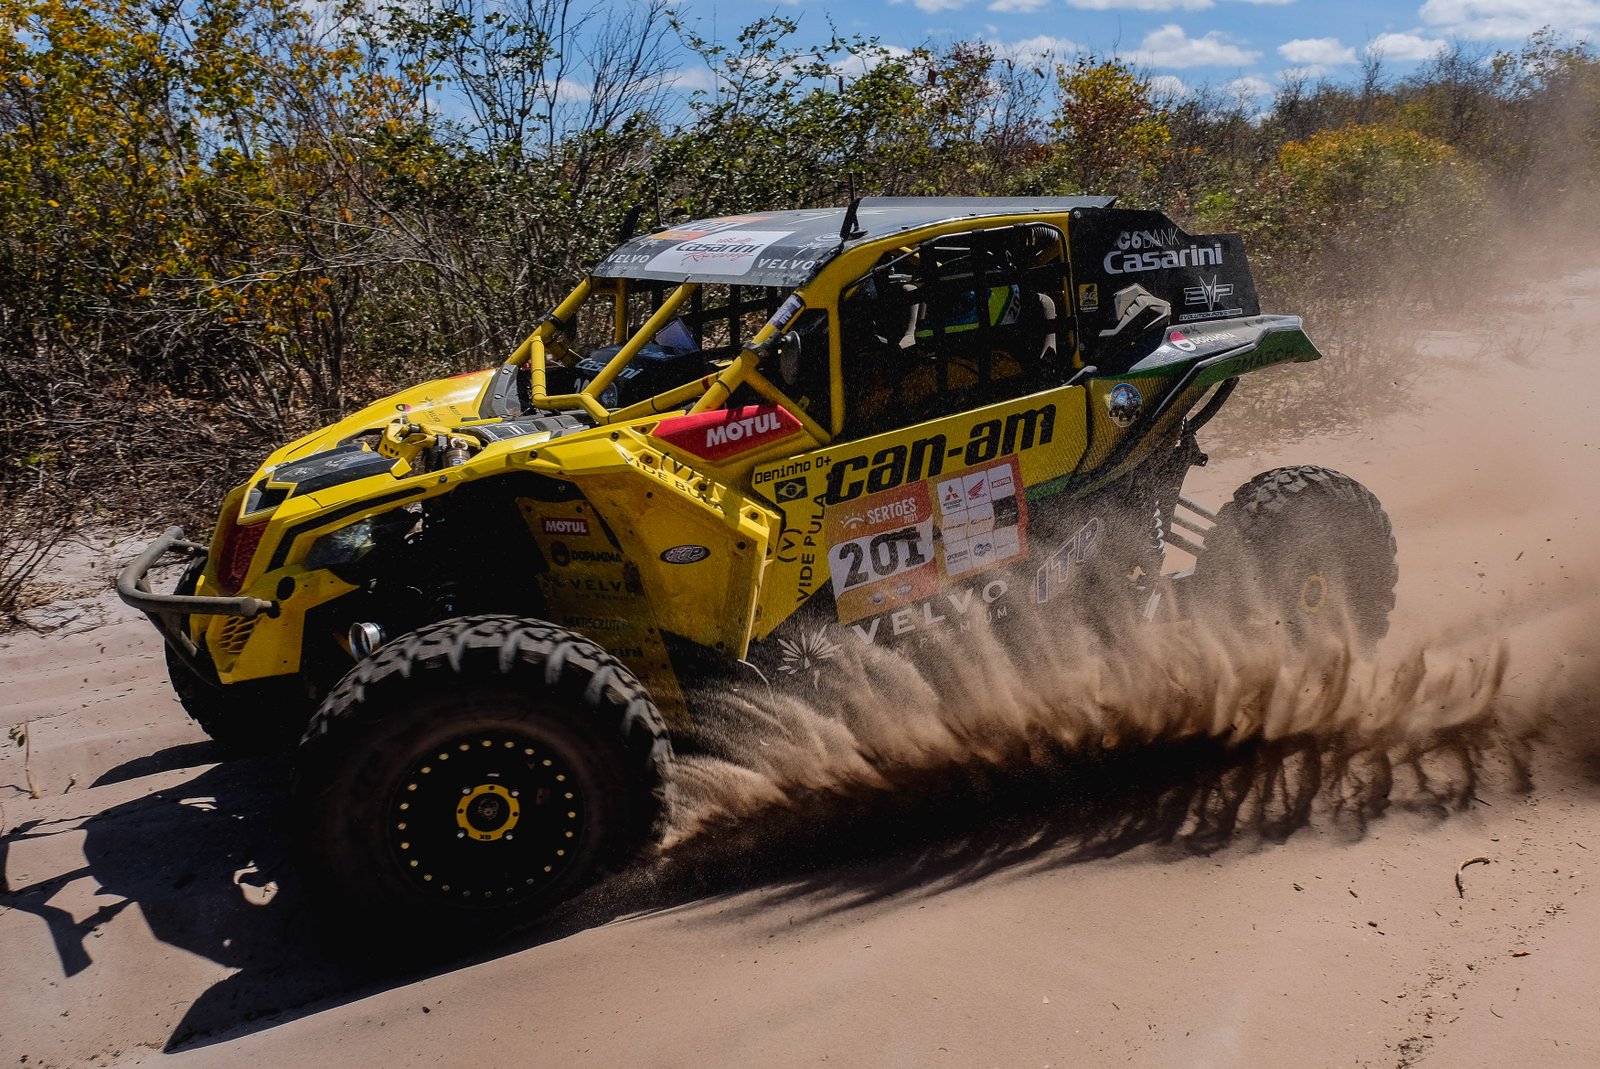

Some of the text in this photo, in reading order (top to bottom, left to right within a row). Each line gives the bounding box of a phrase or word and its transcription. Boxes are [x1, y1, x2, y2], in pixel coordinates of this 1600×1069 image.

[606, 253, 651, 264] VELVO
[675, 241, 765, 254] Casarini
[1103, 244, 1223, 275] Casarini
[757, 258, 816, 271] VELVO
[706, 412, 781, 448] MOTUL
[825, 403, 1057, 506] can-am
[754, 456, 812, 485] Deninho
[545, 519, 588, 534] MOTUL
[839, 526, 926, 589] 201
[796, 553, 816, 602] VIDE
[851, 579, 1009, 645] VELVO
